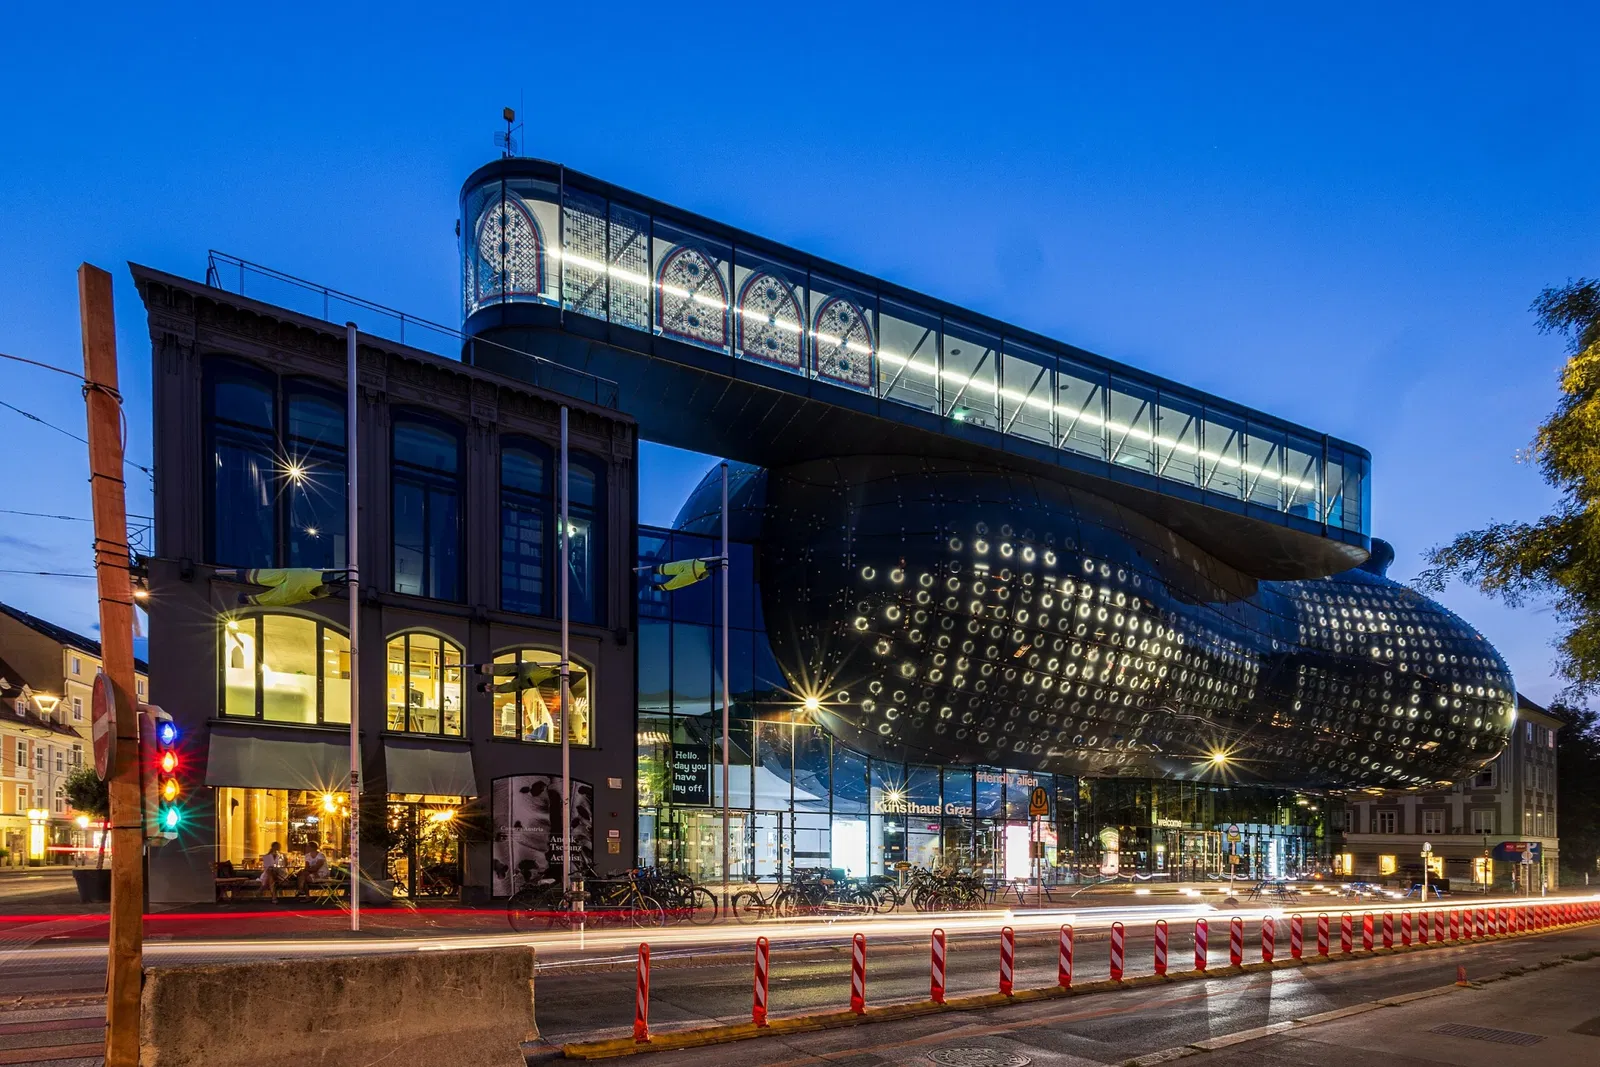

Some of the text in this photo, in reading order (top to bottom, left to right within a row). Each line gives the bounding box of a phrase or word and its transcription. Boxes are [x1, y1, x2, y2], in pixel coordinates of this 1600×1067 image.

[666, 761, 707, 773] tday you
[675, 772, 697, 781] have
[976, 771, 1039, 787] friendly alien
[688, 784, 705, 793] off.
[874, 801, 973, 816] Kunsthaus Graz
[1157, 816, 1182, 828] welcome
